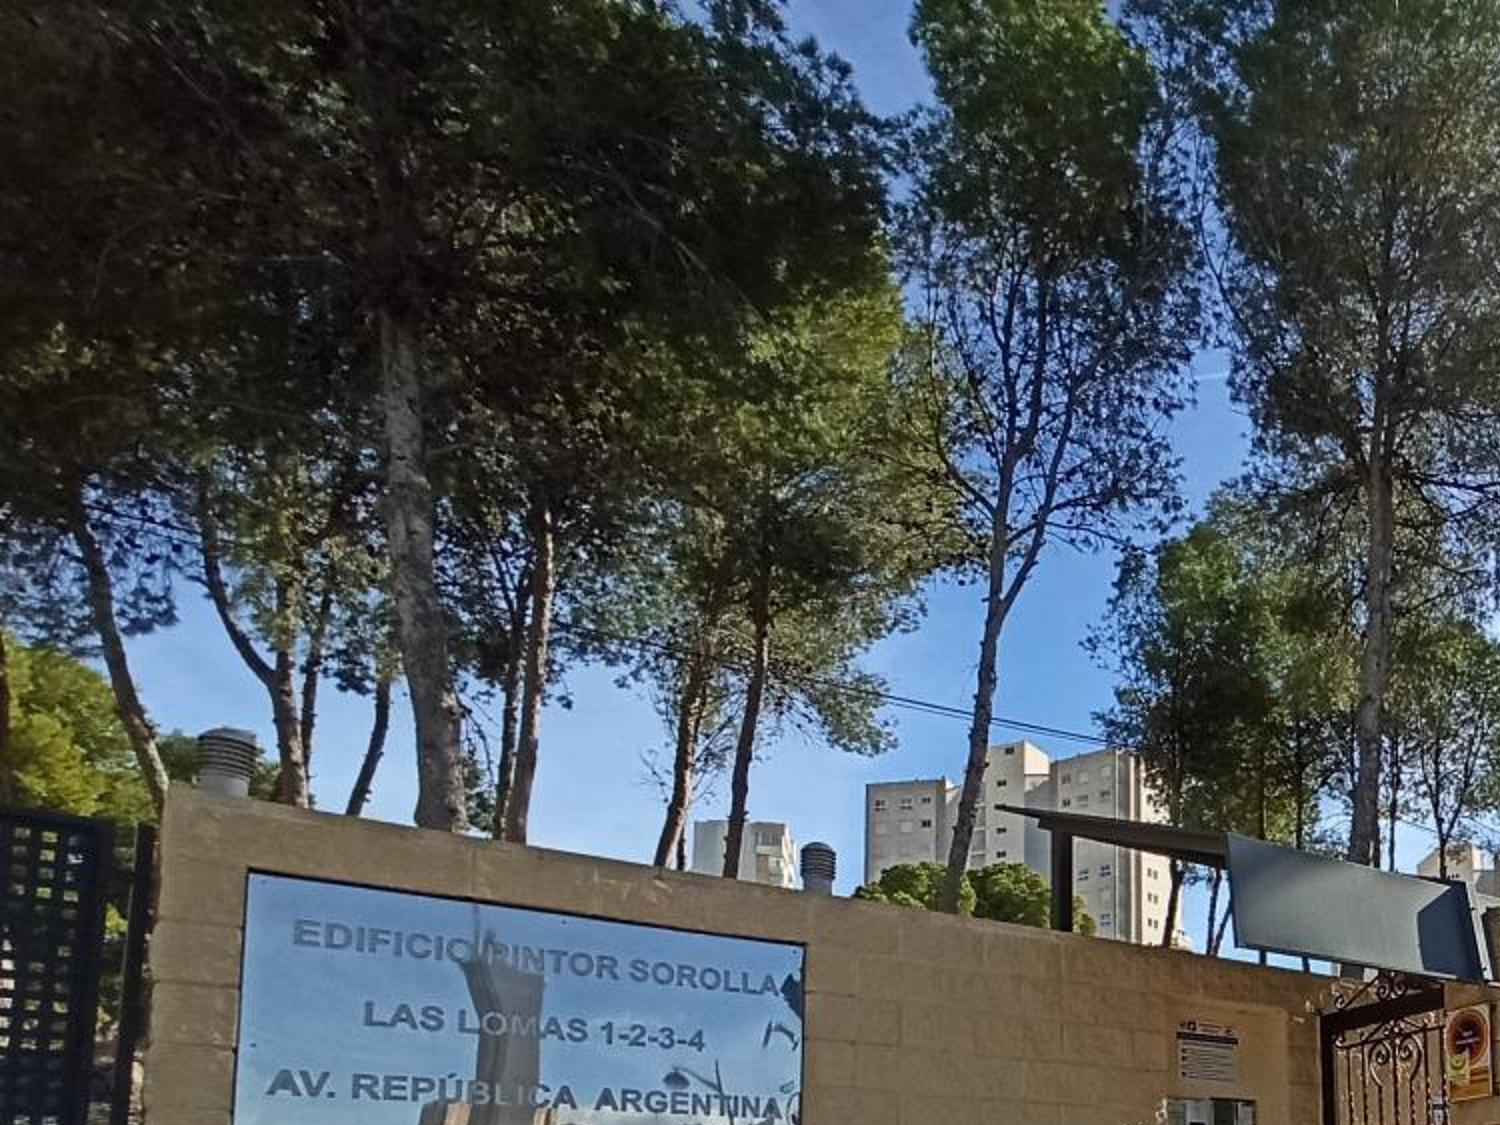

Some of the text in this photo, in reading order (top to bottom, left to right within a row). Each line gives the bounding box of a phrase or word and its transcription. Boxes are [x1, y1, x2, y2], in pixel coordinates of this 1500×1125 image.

[293, 919, 780, 997] EDIFICIO PINTOR SOROLLA
[364, 1000, 706, 1053] LAS LOMAS 1-2-3-4
[265, 1068, 781, 1118] AV. REPÚBLICA ARGENTINA
